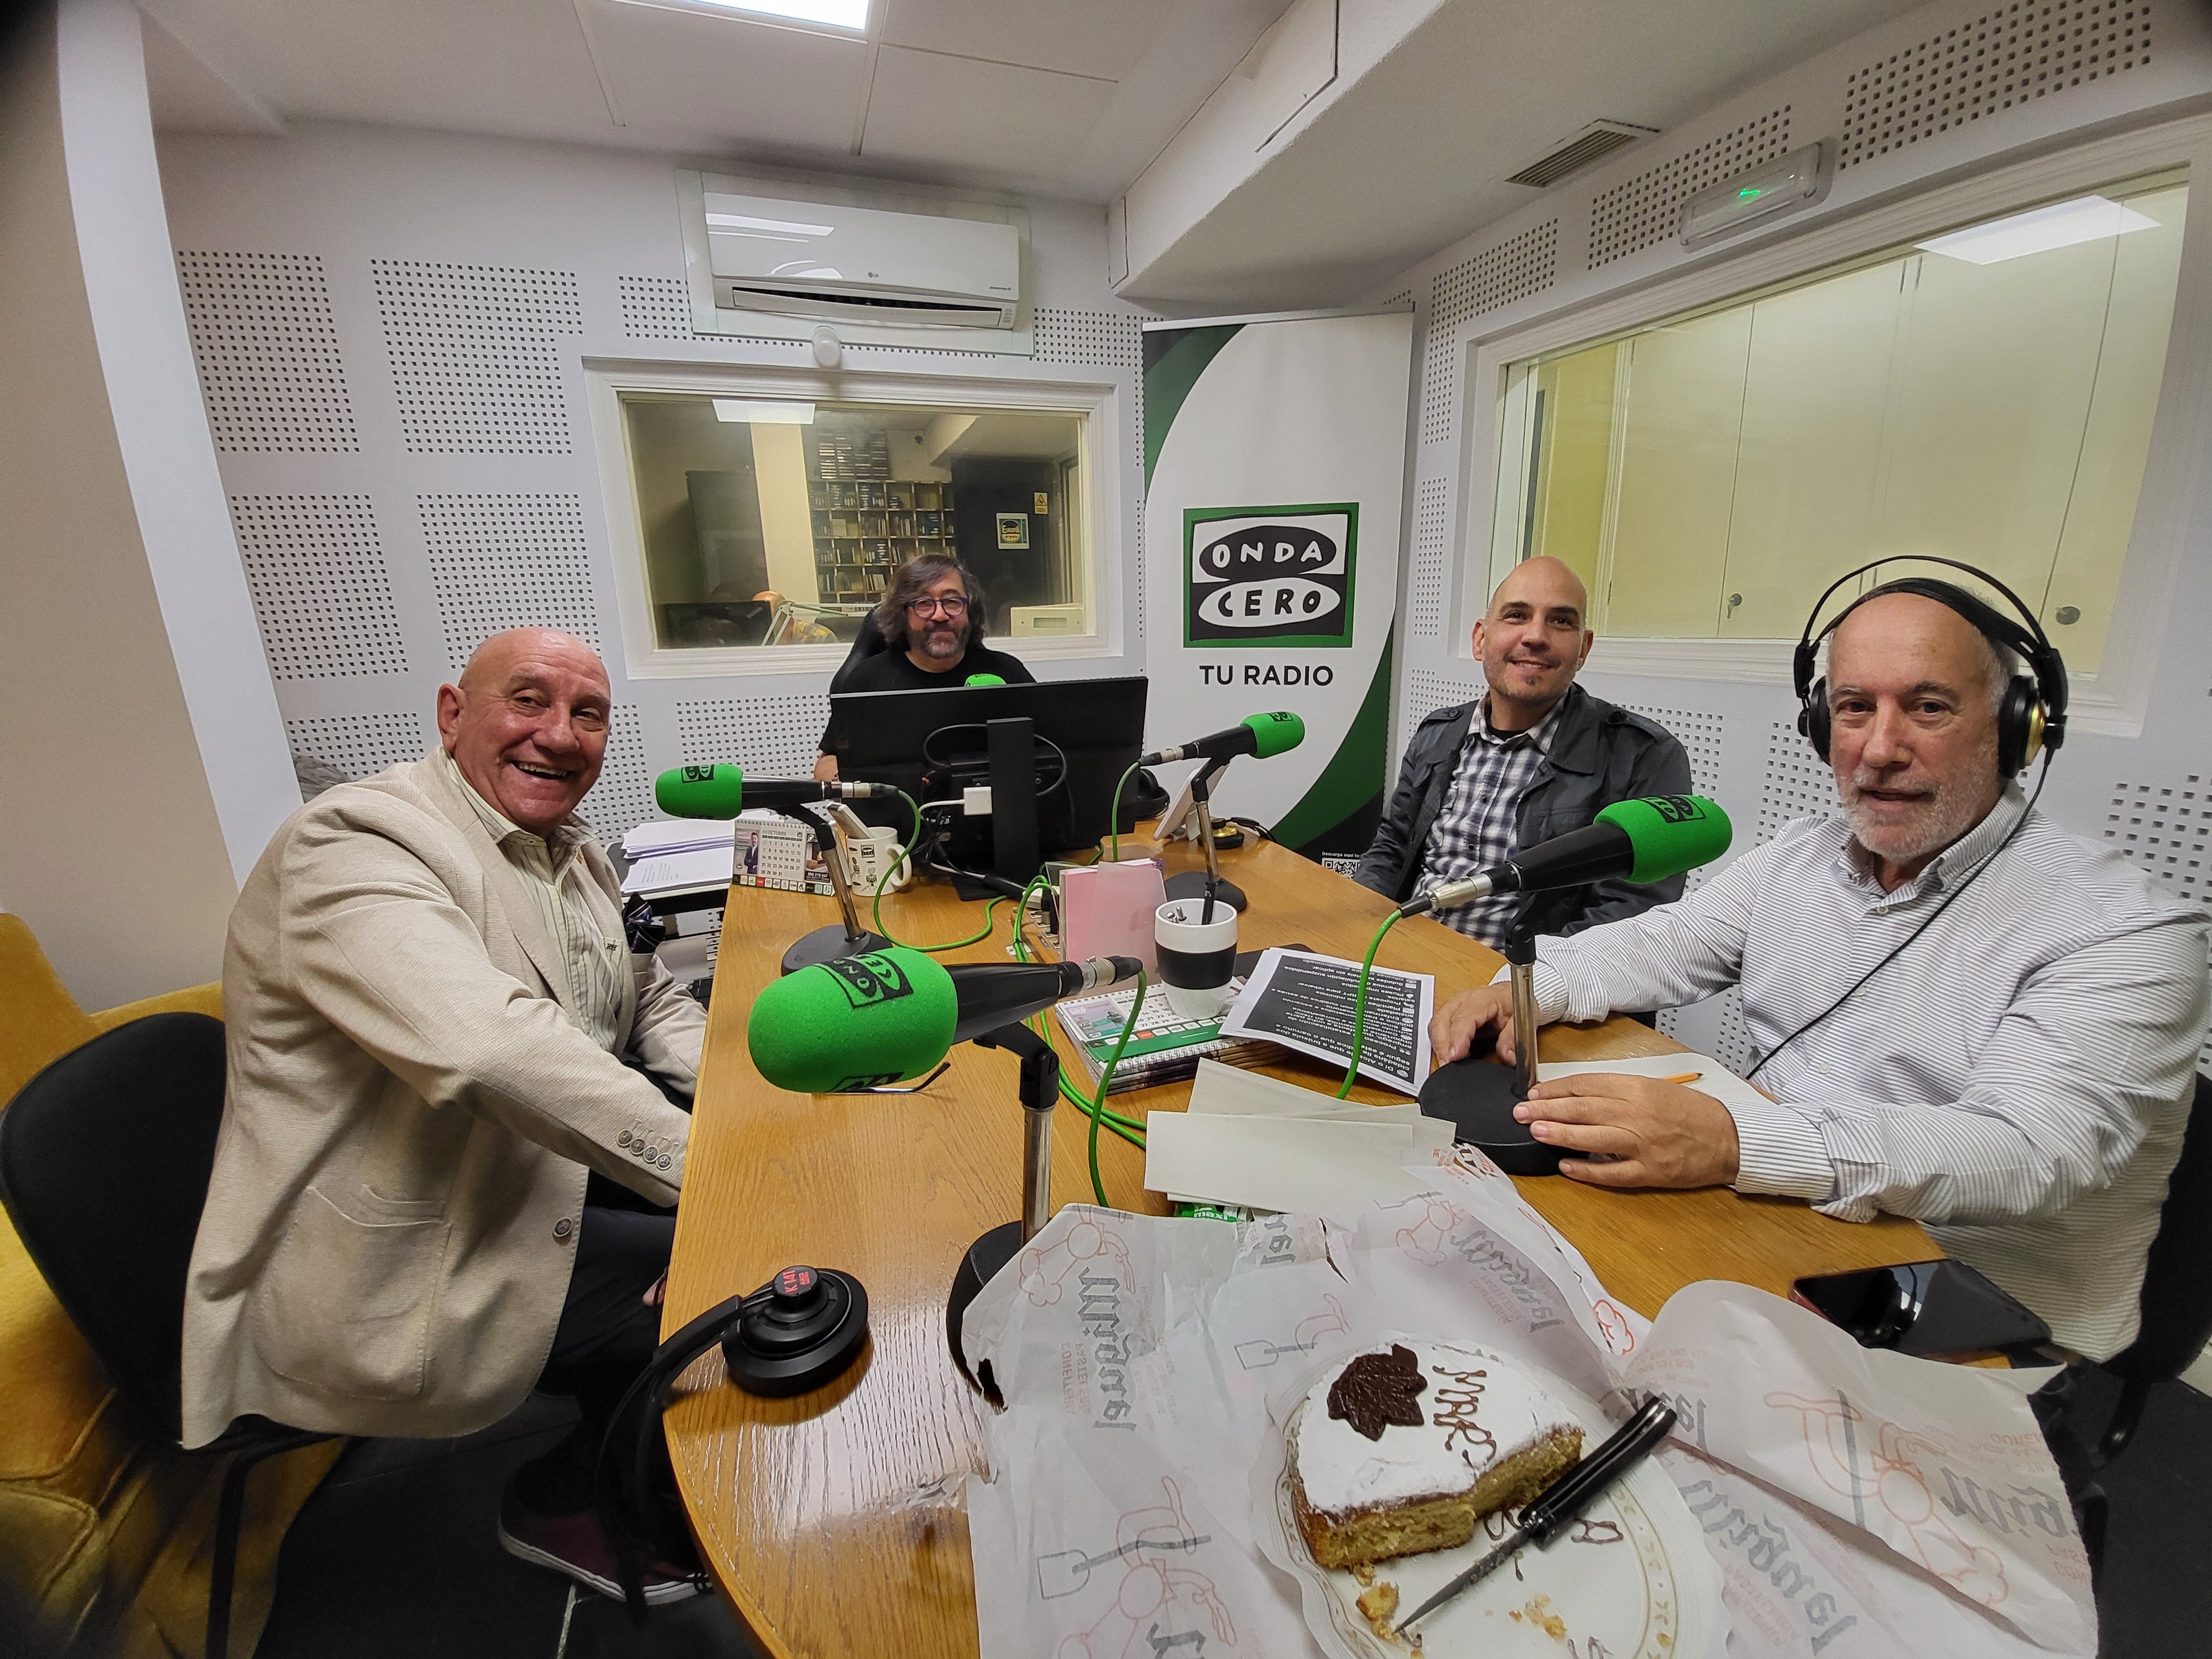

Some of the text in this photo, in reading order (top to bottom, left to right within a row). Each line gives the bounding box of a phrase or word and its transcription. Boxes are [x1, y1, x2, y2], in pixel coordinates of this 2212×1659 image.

[1212, 541, 1322, 568] ONDA
[1218, 589, 1321, 617] CERO
[1199, 665, 1333, 686] TU RADIO
[1373, 983, 1401, 991] Premios
[1368, 1001, 1400, 1011] Plantillas
[1369, 997, 1401, 1005] Proposta
[1321, 1008, 1356, 1018] ometidos
[1282, 1026, 1311, 1036] camiño
[1299, 1019, 1350, 1035] estabilización
[1292, 1033, 1321, 1045] brúxula
[1364, 1037, 1396, 1050] Proceso
[1346, 1051, 1376, 1063] Alcae
[1386, 1054, 1410, 1066] seguir
